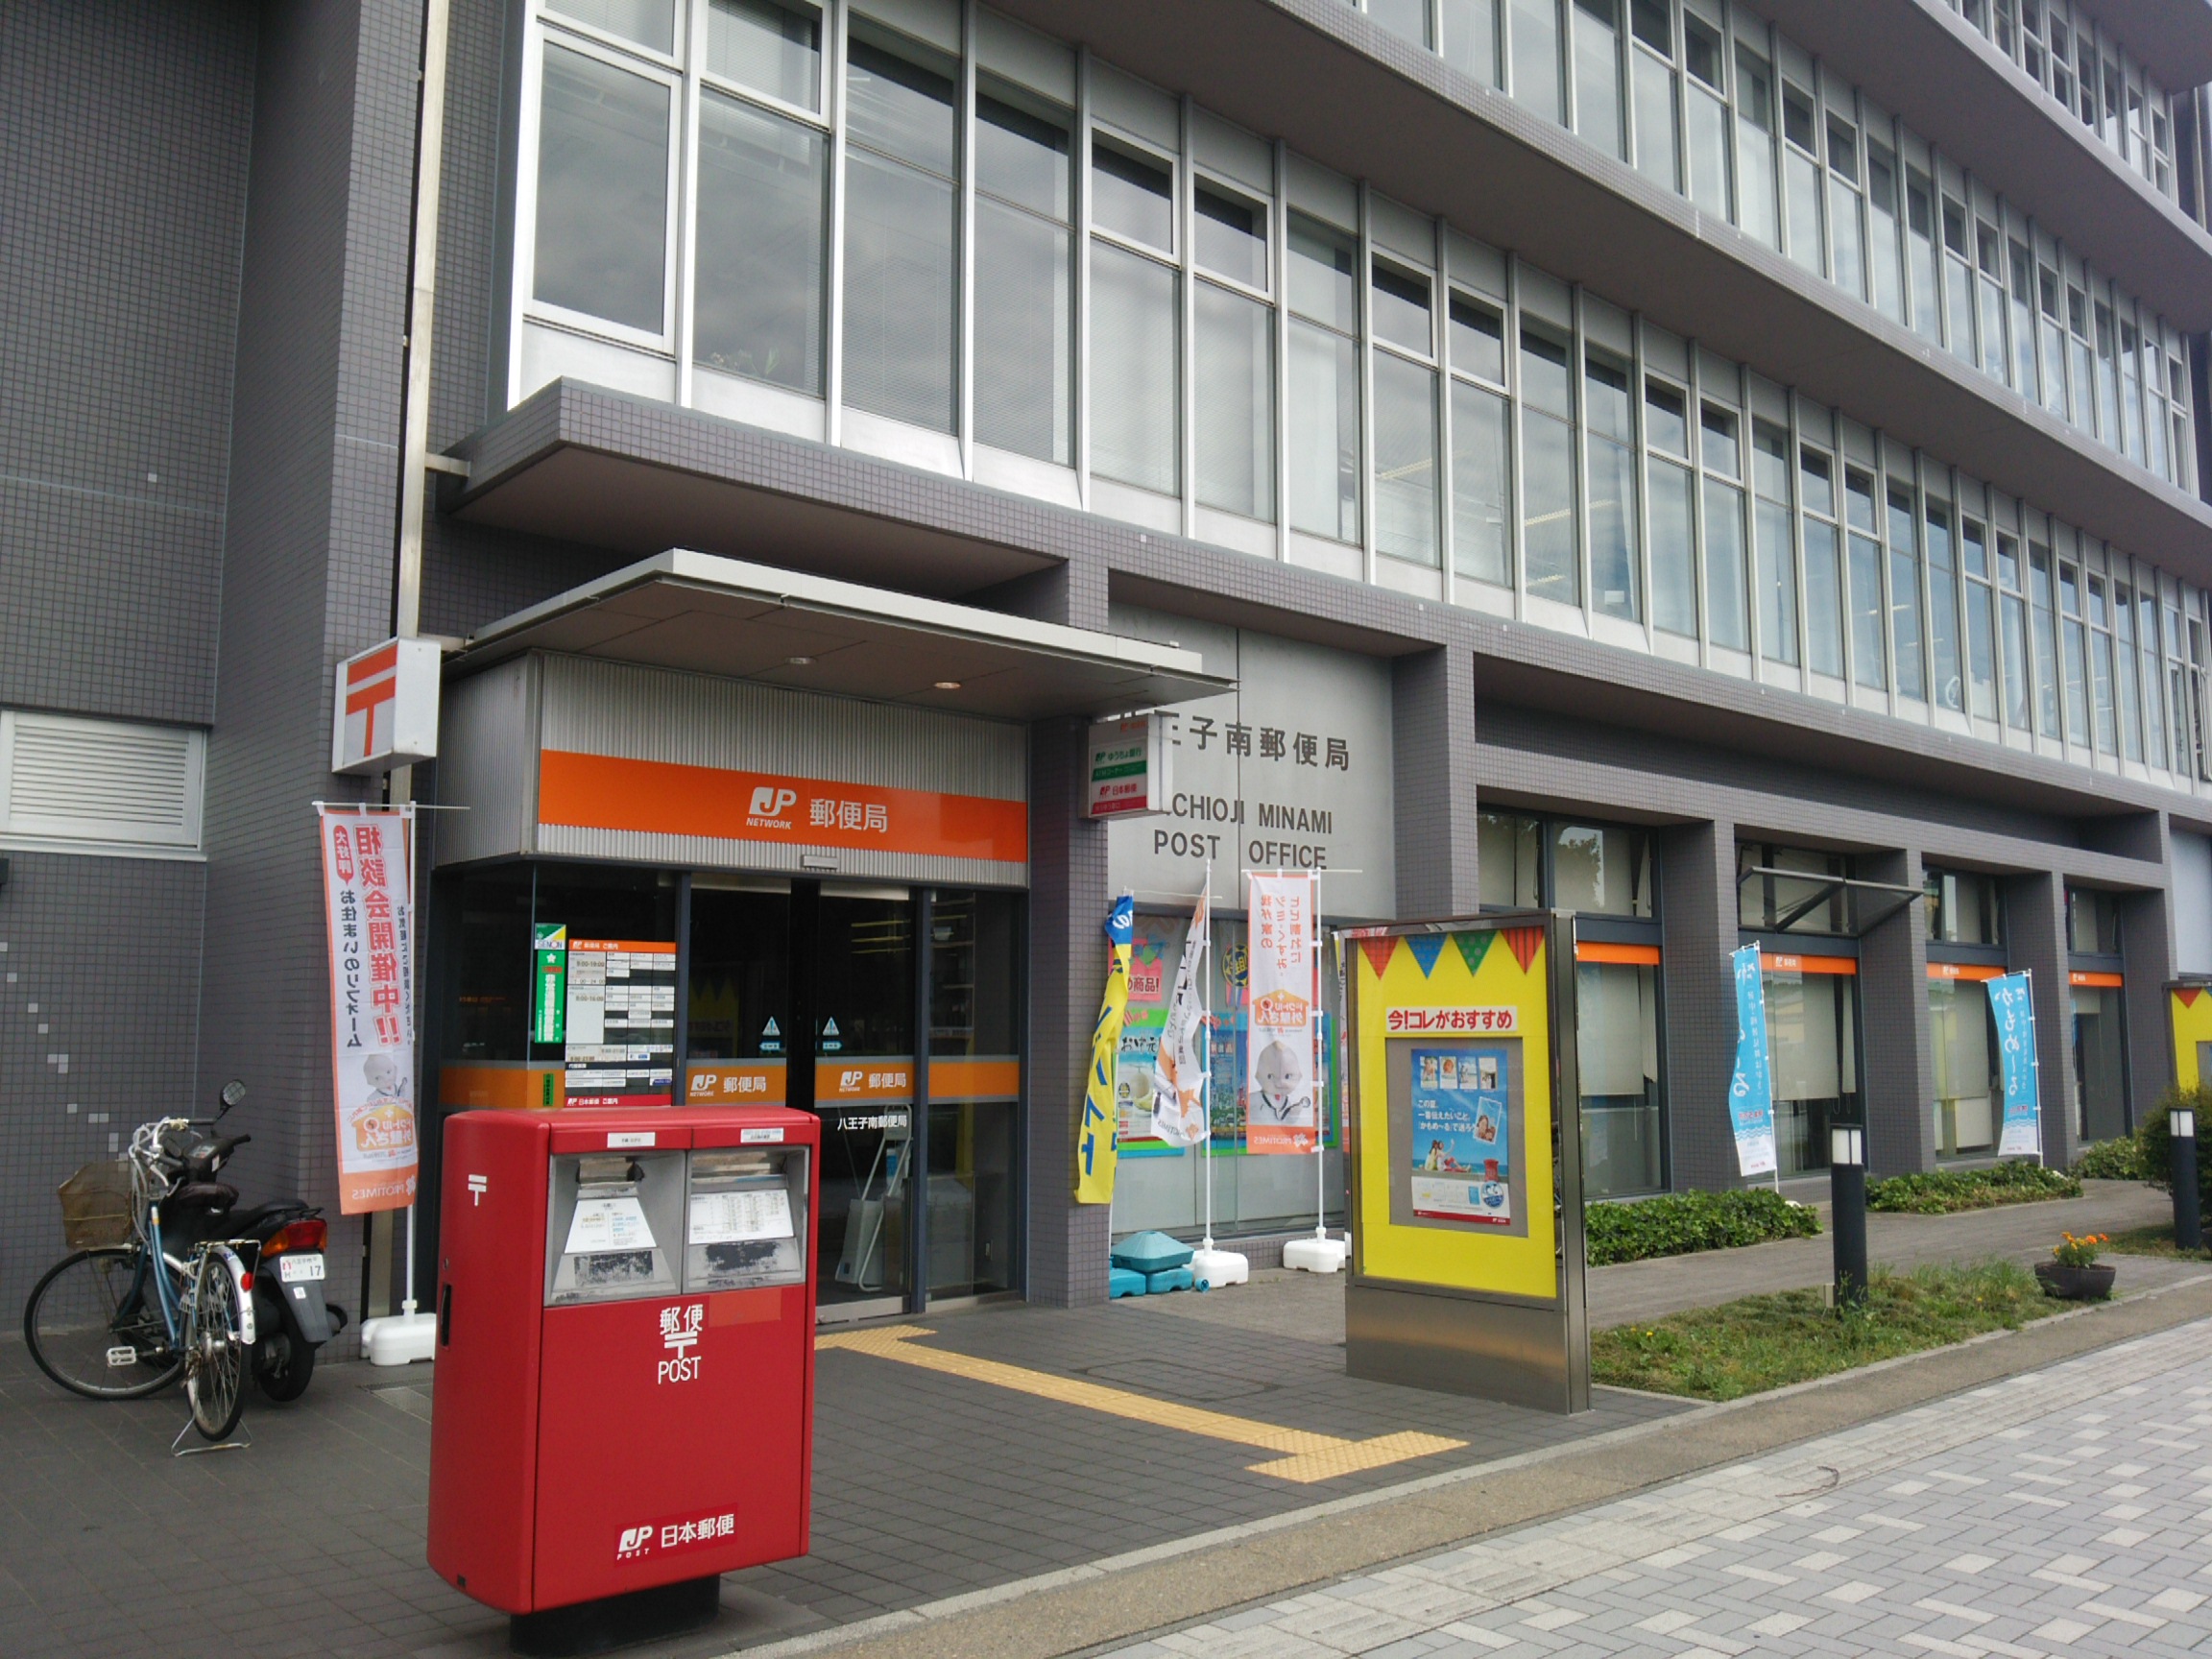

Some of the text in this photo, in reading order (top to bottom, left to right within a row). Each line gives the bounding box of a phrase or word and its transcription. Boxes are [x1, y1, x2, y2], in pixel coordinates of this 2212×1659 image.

[1112, 783, 1137, 795] 日本郵便
[749, 786, 797, 816] JP
[746, 818, 792, 830] NETWORK
[809, 798, 888, 833] 郵便局
[1259, 803, 1333, 834] MINAMI
[1154, 830, 1327, 870] POST OFFICE
[537, 939, 563, 950] SENON
[691, 1074, 716, 1091] JP
[723, 1076, 766, 1094] 郵便局
[840, 1070, 862, 1087] JP
[868, 1072, 906, 1090] 郵便局
[837, 1115, 907, 1131] 八王子南郵便局
[660, 1304, 703, 1334] 郵便
[659, 1356, 702, 1384] POST
[618, 1513, 734, 1552] JP 日本郵便
[617, 1548, 650, 1560] POST
